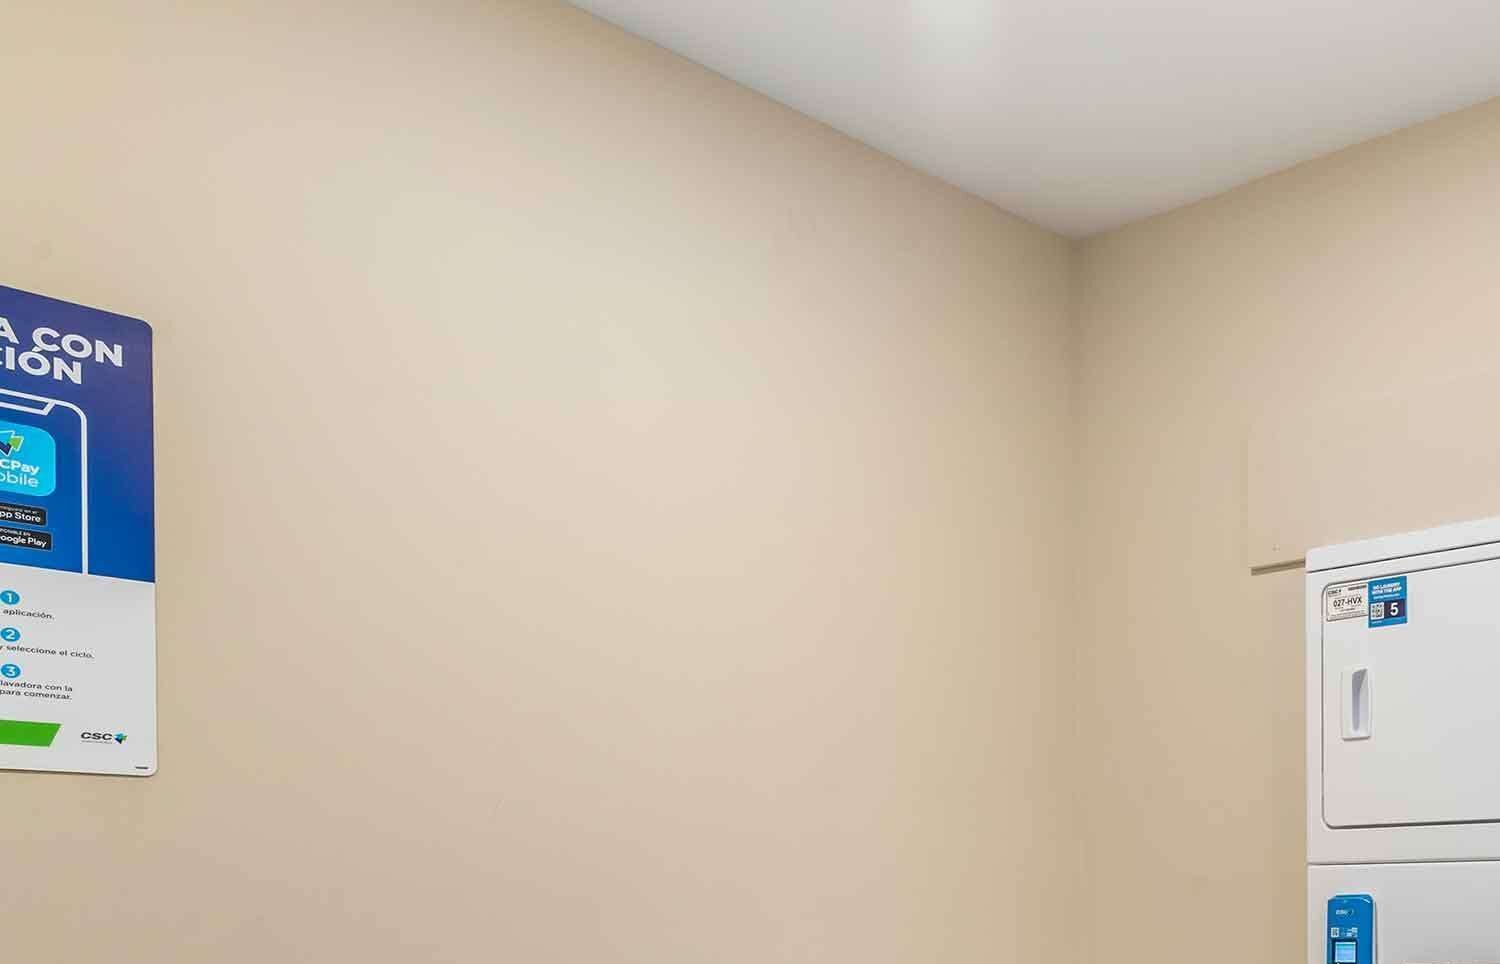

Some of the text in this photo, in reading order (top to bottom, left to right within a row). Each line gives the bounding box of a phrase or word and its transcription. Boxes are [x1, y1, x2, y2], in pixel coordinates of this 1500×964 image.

[32, 327, 123, 367] CON
[0, 346, 82, 385] IÓN
[14, 511, 41, 523] Store
[27, 537, 47, 548] Play
[7, 592, 12, 603] 1
[3, 608, 55, 620] aplicación.
[1390, 602, 1399, 616] 5
[6, 629, 16, 640] 2
[6, 645, 57, 655] seleccione
[59, 649, 68, 657] el
[7, 665, 16, 677] 3
[44, 683, 63, 692] con
[80, 731, 113, 741] CSC
